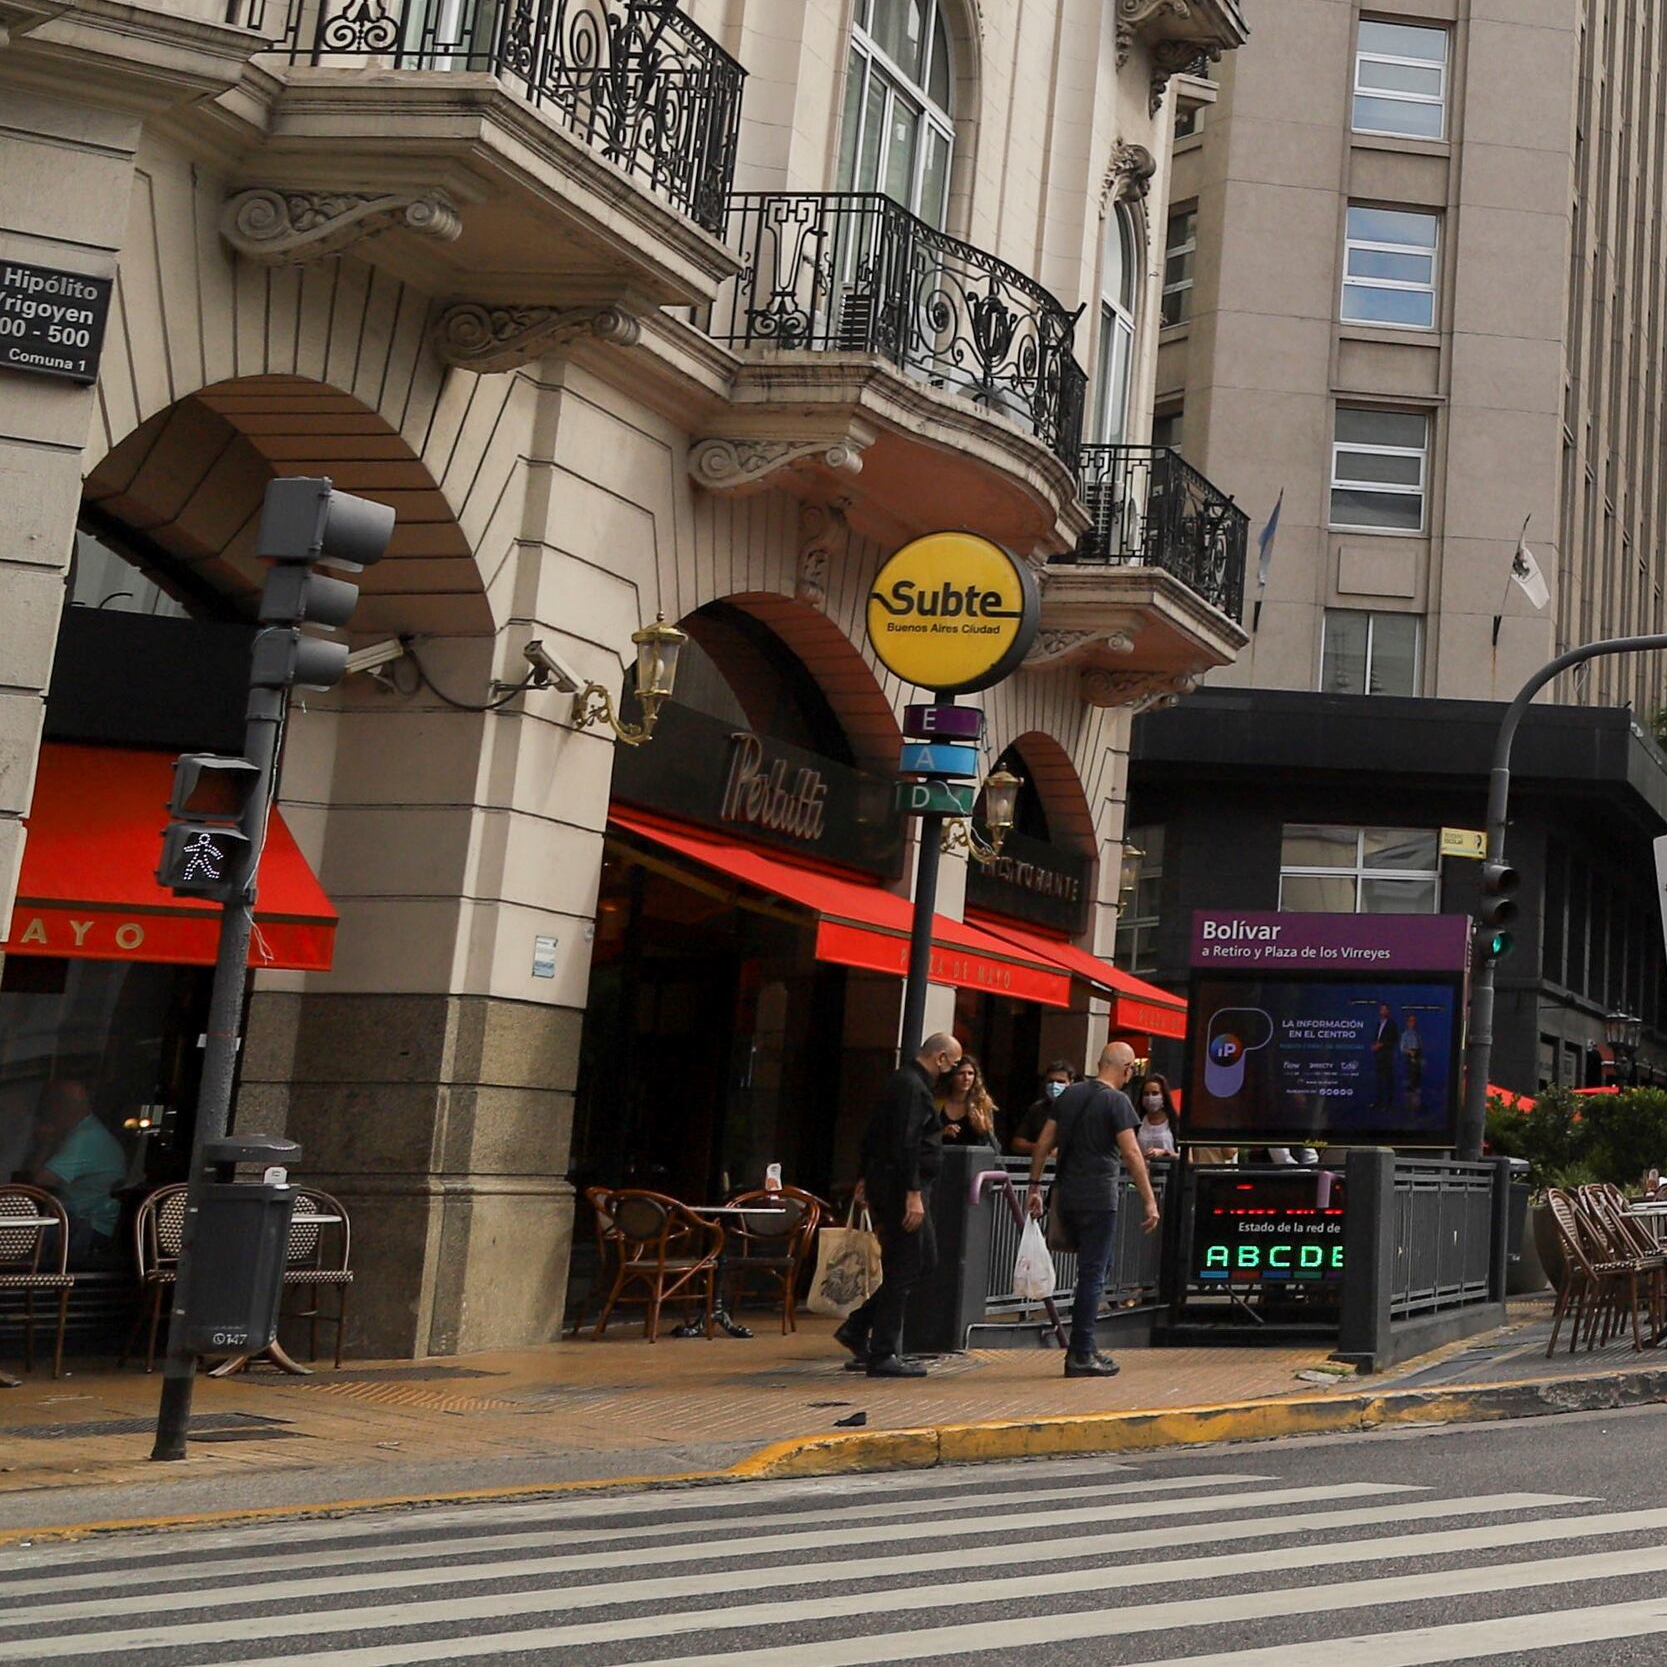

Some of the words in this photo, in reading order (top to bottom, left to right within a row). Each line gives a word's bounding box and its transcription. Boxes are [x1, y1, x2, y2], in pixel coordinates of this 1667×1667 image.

[4, 267, 98, 300] Hipólito
[48, 325, 90, 348] 500
[9, 347, 73, 370] Comuna
[79, 360, 86, 372] 1
[892, 580, 1003, 618] Subte
[887, 622, 928, 633] Buenos
[931, 623, 958, 634] Aires
[962, 624, 1000, 635] Ciudad
[922, 708, 937, 731] E
[915, 746, 936, 769] A
[911, 785, 931, 808] D
[1202, 920, 1281, 940] Bolívar
[1202, 947, 1210, 957] a
[1213, 945, 1251, 957] Retiro
[1254, 949, 1262, 960] y
[1265, 946, 1298, 958] Plaza
[1301, 946, 1317, 958] de
[1320, 947, 1337, 958] los
[1341, 947, 1390, 962] Virreyes
[1282, 1020, 1295, 1028] LA
[1297, 1019, 1364, 1029] INFORMACIÓN
[1289, 1030, 1302, 1038] EN
[1305, 1030, 1316, 1038] EL
[1317, 1030, 1356, 1039] CENTRO
[1238, 1221, 1275, 1233] Estado
[1277, 1221, 1291, 1233] de
[1294, 1221, 1304, 1233] la
[1306, 1222, 1324, 1233] red
[1326, 1222, 1341, 1234] de
